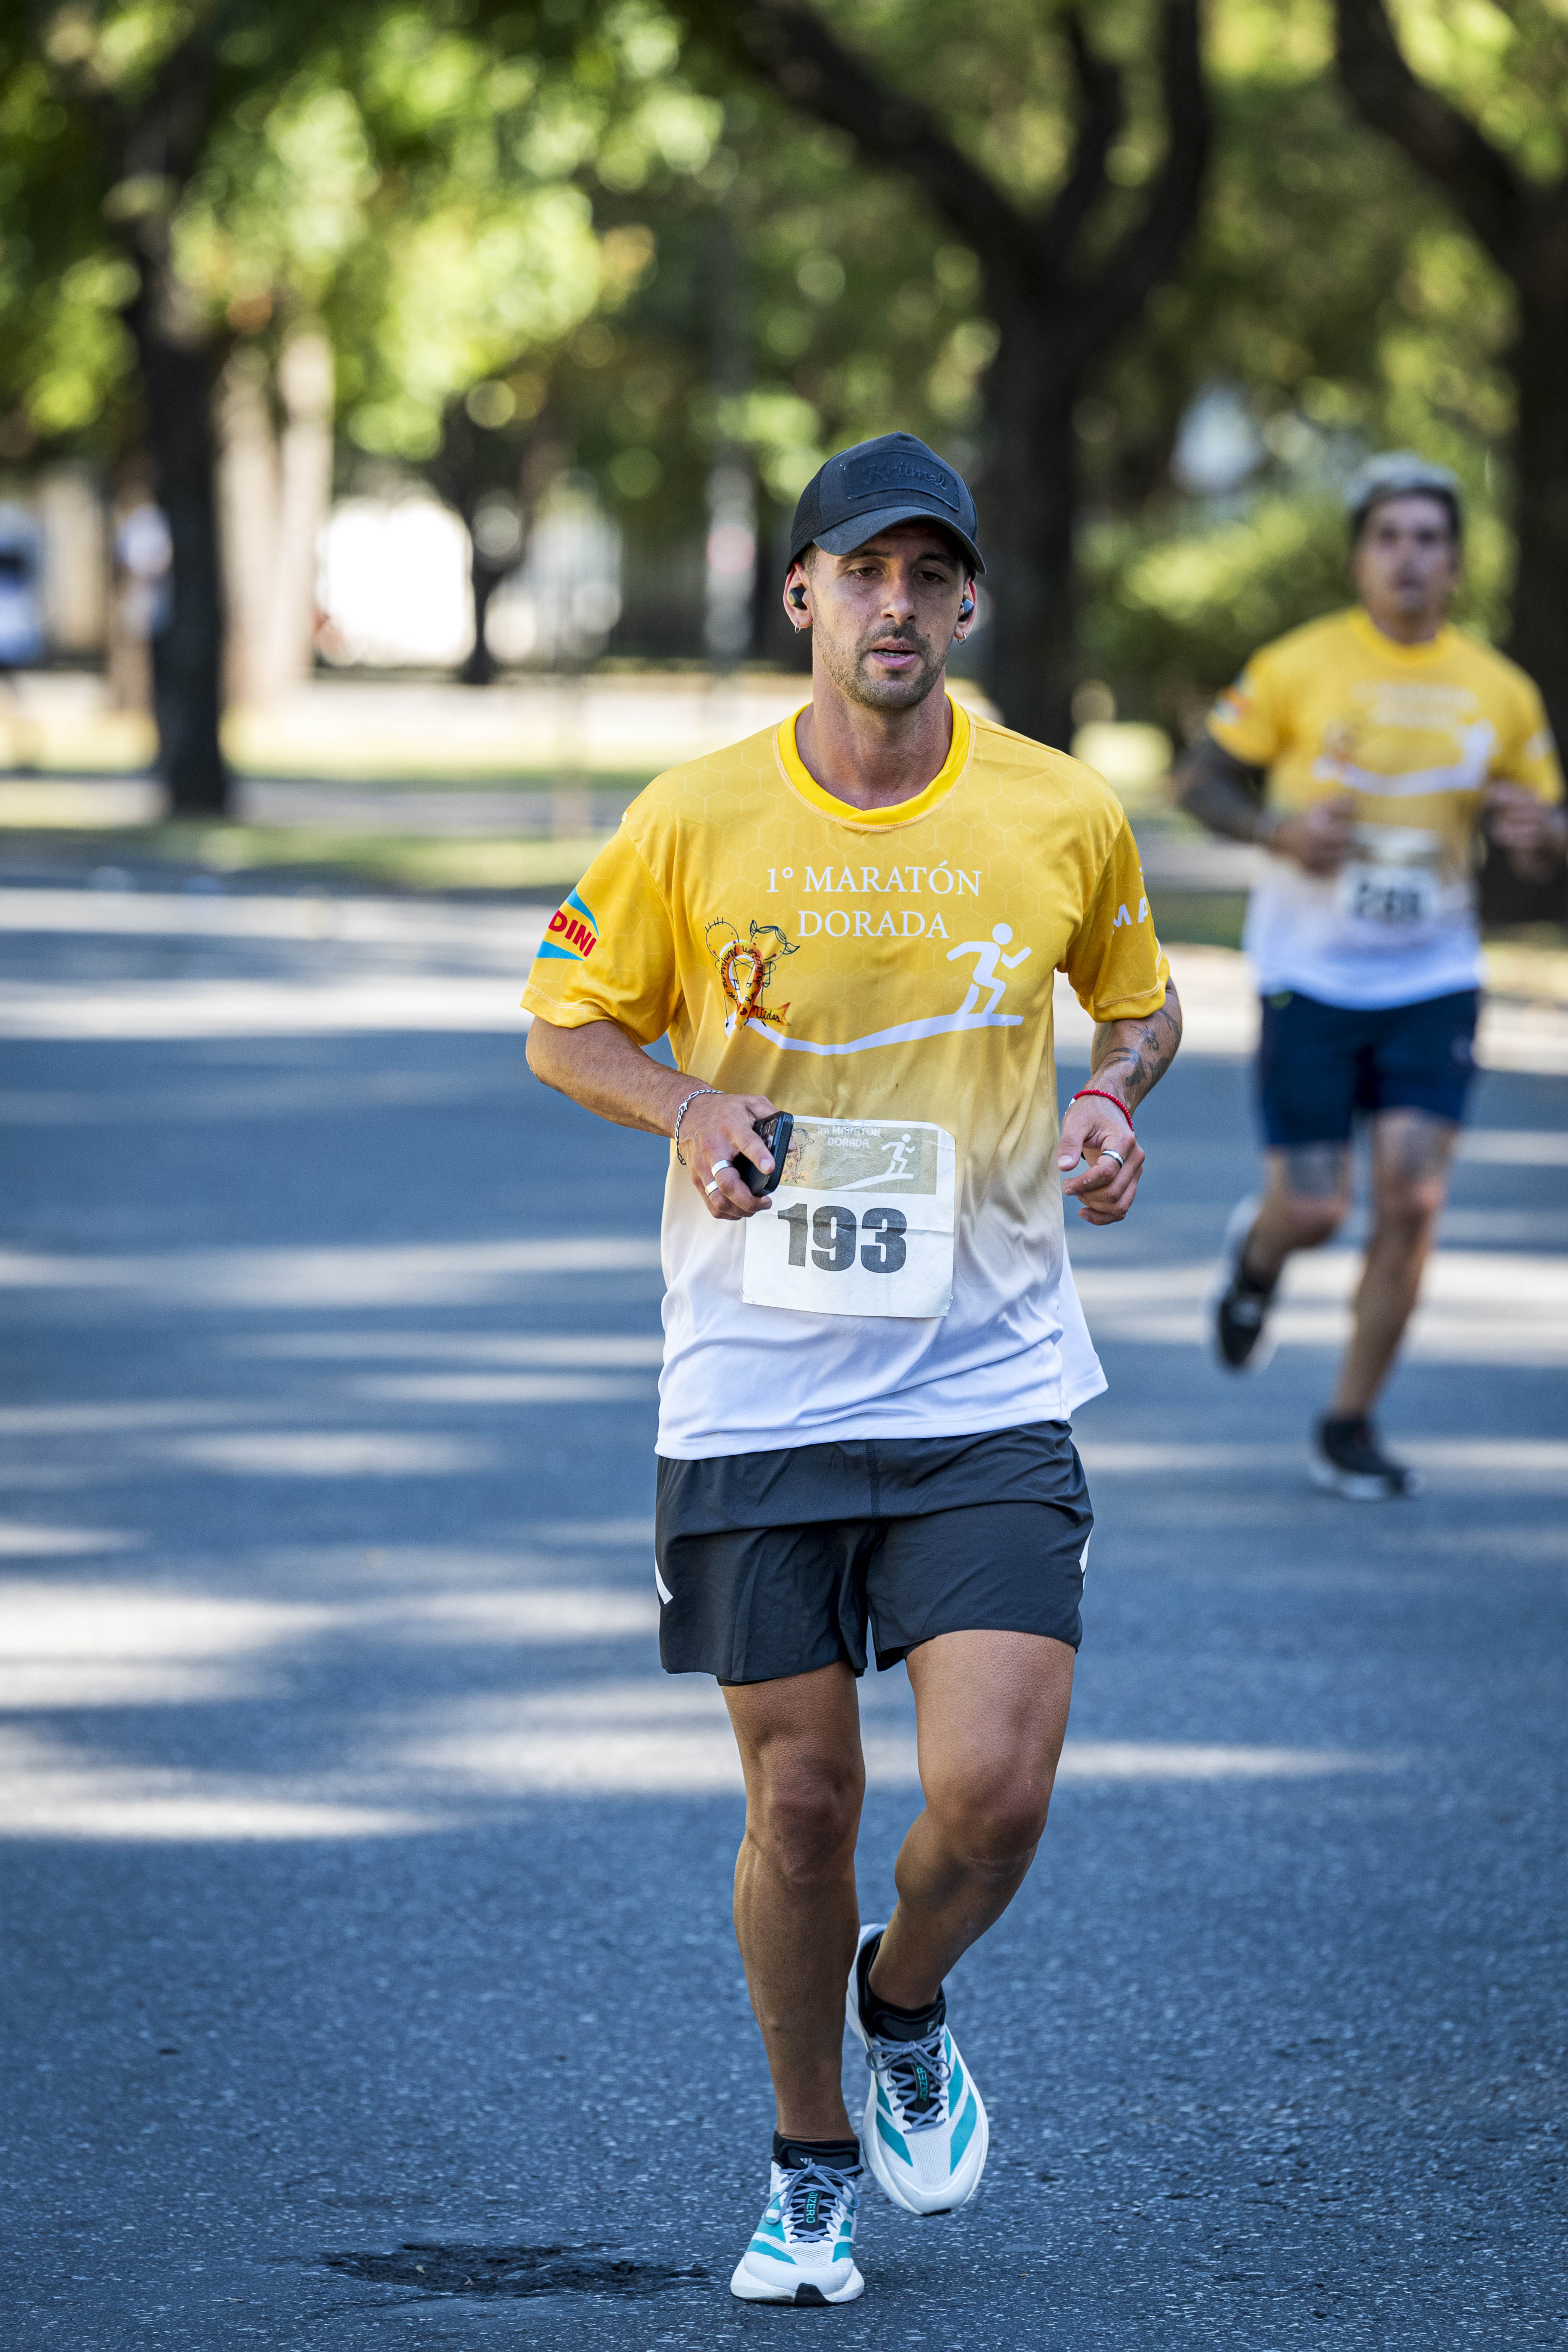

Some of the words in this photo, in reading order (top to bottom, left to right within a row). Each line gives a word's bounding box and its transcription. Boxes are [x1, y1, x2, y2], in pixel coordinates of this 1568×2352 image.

[803, 860, 982, 896] MARATÓN
[797, 910, 950, 938] DORADA
[828, 1137, 869, 1147] DORADA
[777, 1203, 907, 1274] 193
[806, 2191, 819, 2223] DIZERO
